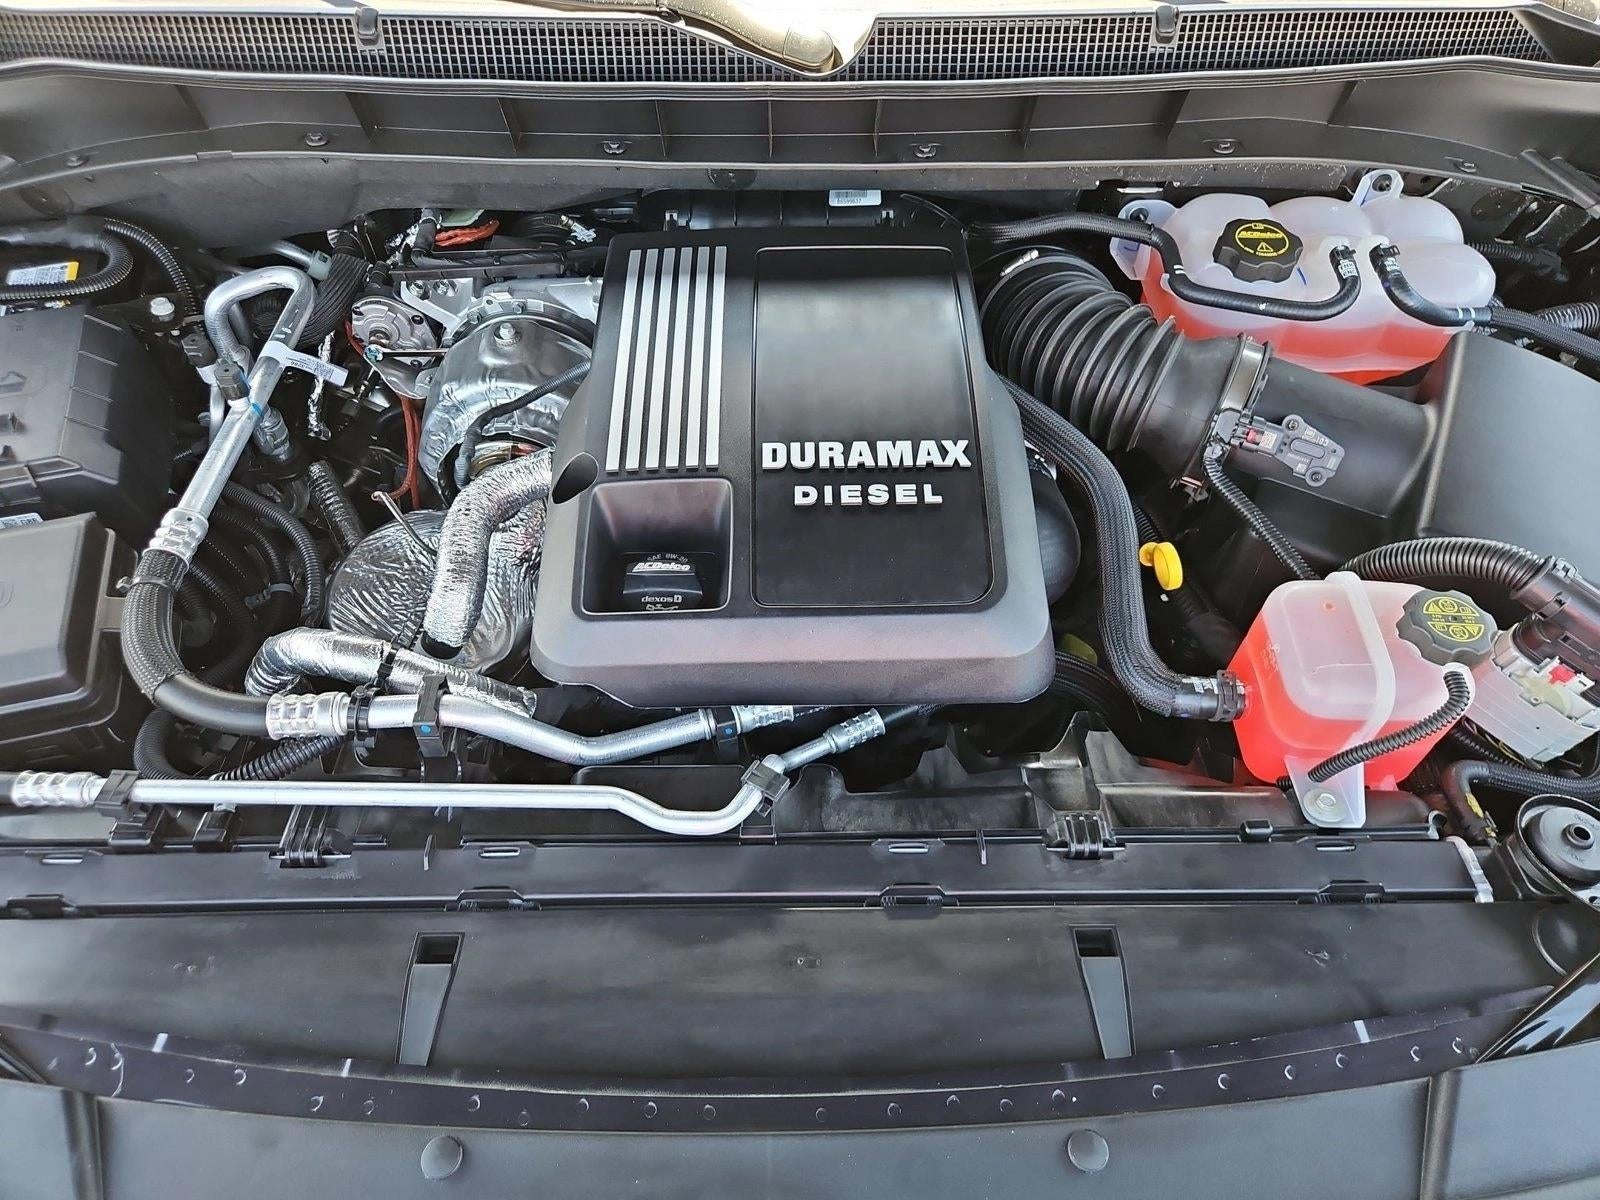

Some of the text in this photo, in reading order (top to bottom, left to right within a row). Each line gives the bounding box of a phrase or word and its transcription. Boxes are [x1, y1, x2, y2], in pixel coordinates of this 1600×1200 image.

[761, 440, 972, 469] DURAMAX
[794, 484, 943, 506] DIESEL
[647, 553, 662, 561] SAE
[631, 562, 691, 572] ACDelco
